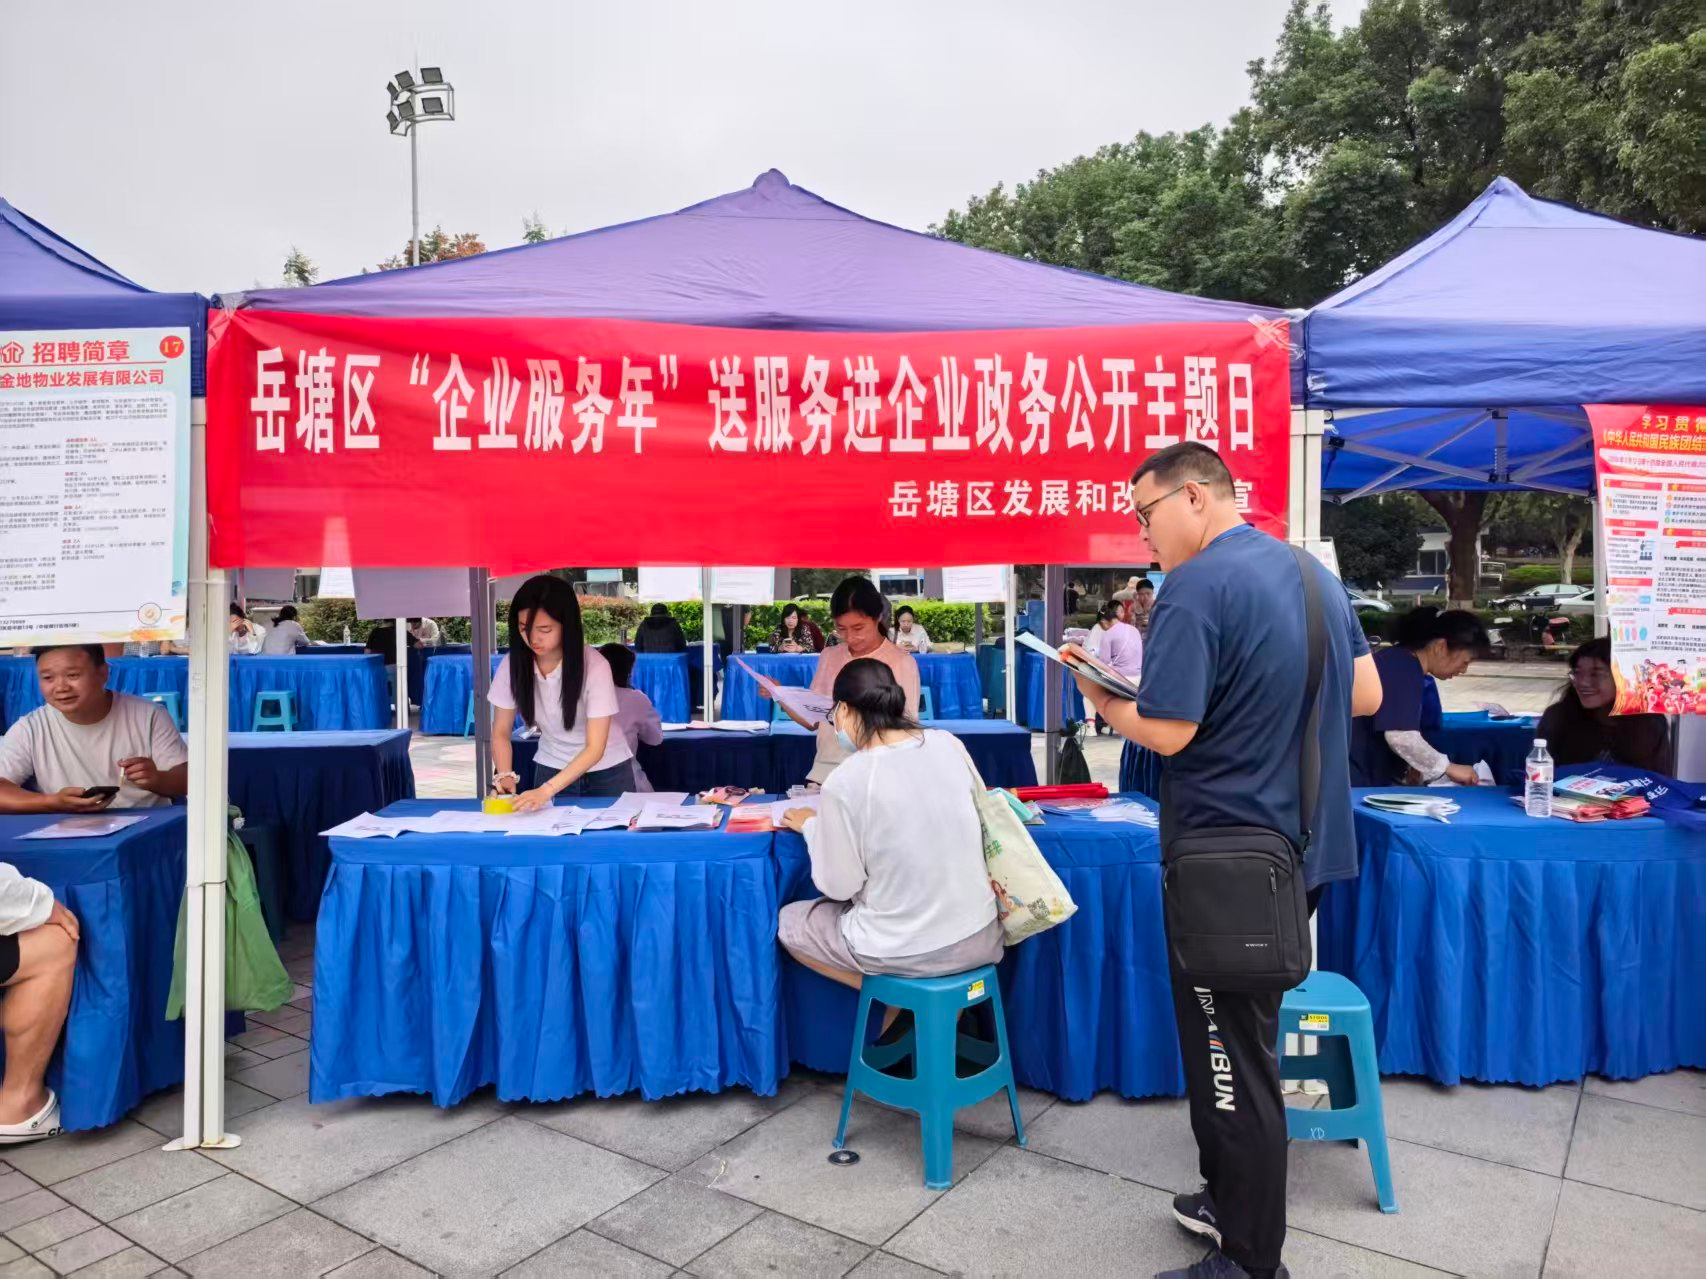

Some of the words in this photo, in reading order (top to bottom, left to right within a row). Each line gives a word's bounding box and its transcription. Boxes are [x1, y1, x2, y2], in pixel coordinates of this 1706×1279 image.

[33, 340, 130, 363] 招聘简章
[164, 341, 182, 353] 17
[0, 369, 164, 389] 金地物业发展有限公司
[250, 346, 381, 454] 岳塘区
[409, 352, 679, 455] “企业服务年”
[707, 351, 1254, 456] 送服务进企业政务公开主题日
[887, 478, 1253, 518] 岳塘区发展和改宣
